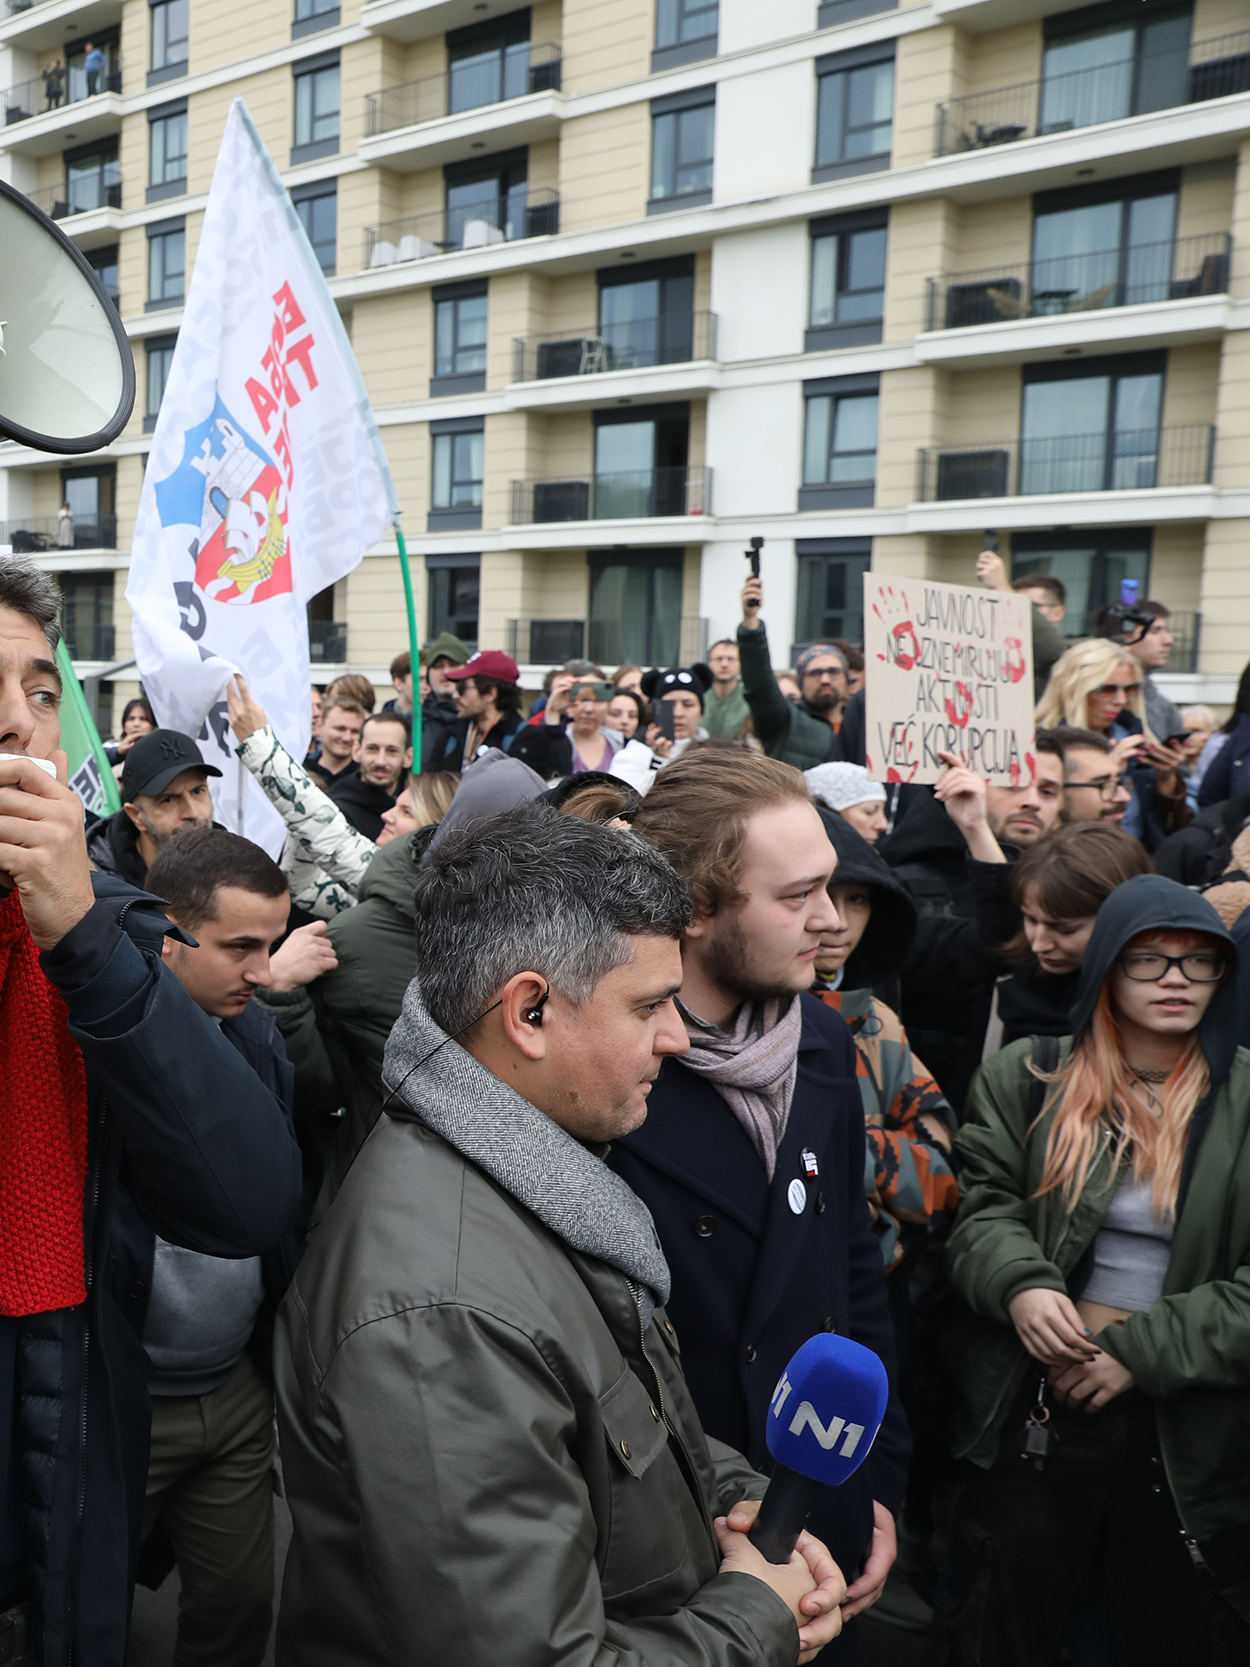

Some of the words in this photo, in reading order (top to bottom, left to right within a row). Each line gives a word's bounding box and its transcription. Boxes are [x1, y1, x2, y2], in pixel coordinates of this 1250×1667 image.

[916, 588, 999, 642] JAVNOST
[916, 673, 1000, 721] AKTIVISTI
[877, 713, 918, 767] VEĆ
[921, 722, 1022, 774] KORUPCIJA
[788, 1400, 866, 1458] N1
